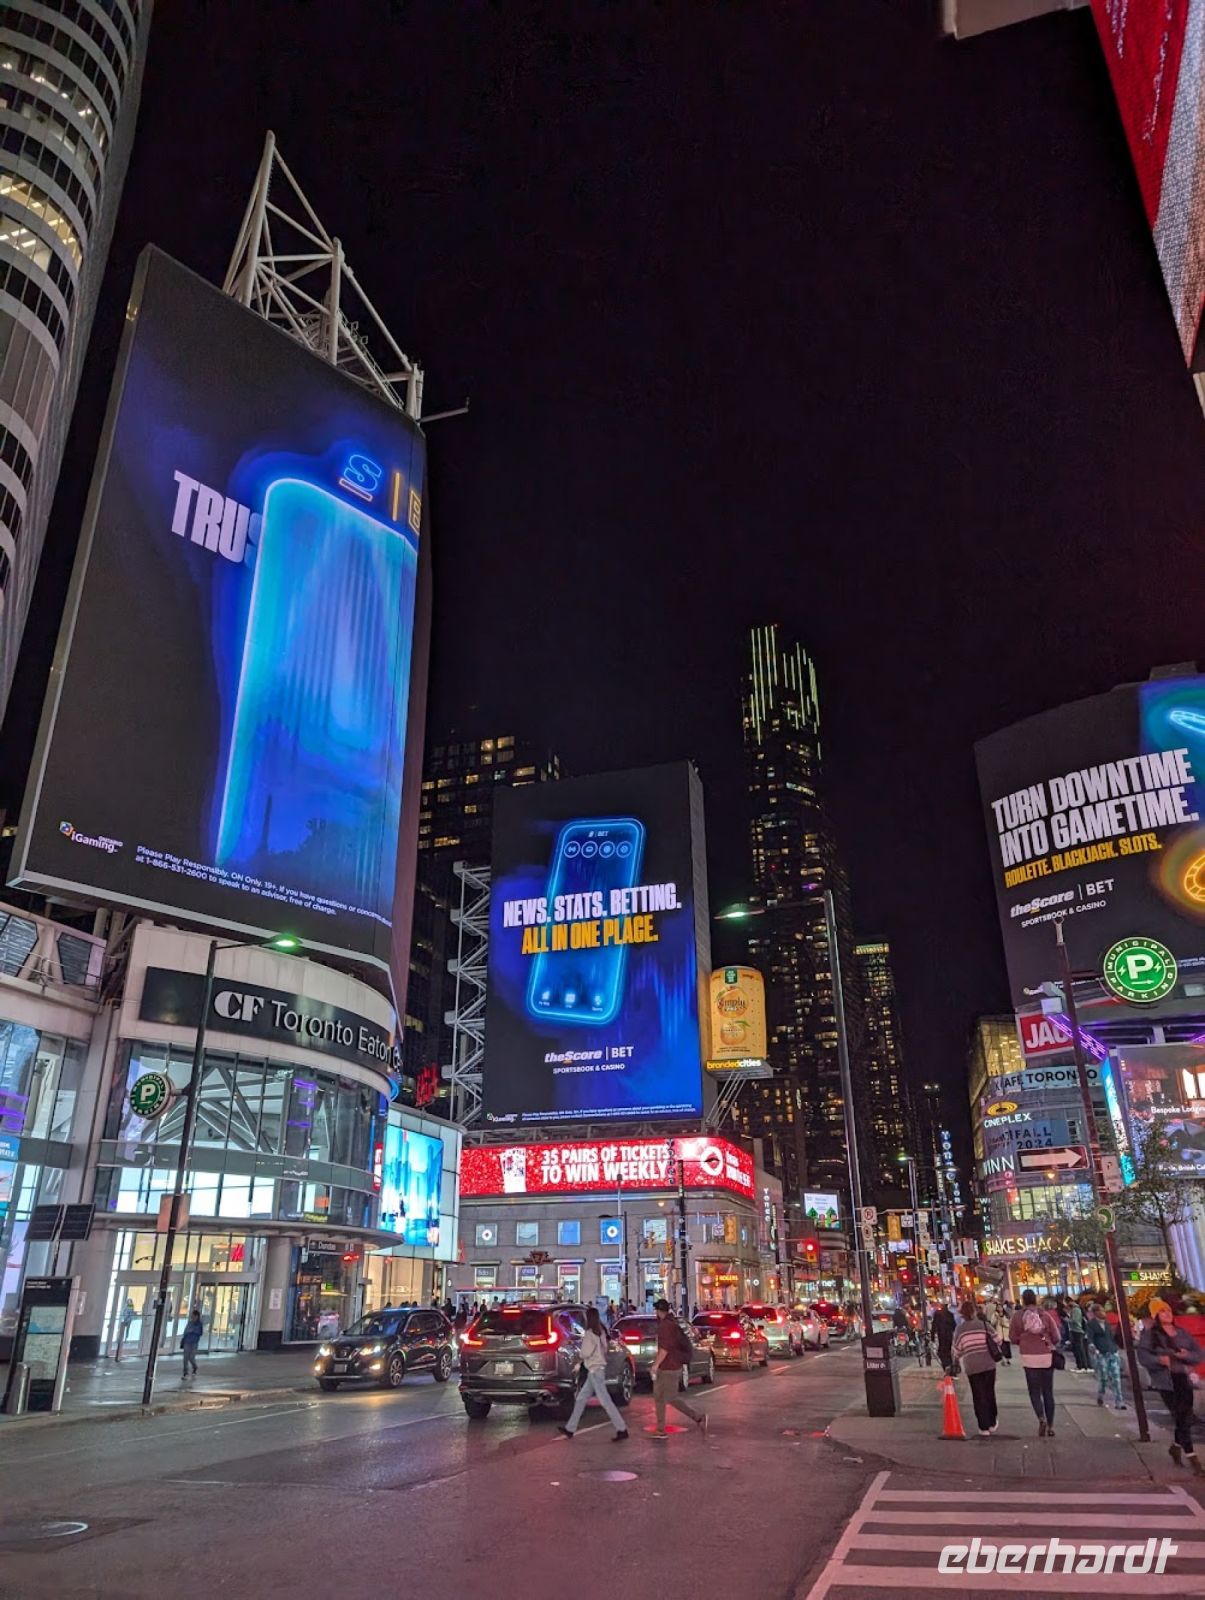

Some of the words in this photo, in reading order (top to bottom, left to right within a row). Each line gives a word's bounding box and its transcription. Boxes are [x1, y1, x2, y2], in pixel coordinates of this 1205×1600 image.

[991, 783, 1050, 834] TURN
[1049, 748, 1195, 813] DOWNTIME
[1000, 819, 1050, 868] INTO
[1051, 786, 1199, 849] GAMETIME.
[71, 831, 118, 854] iGaming
[1004, 858, 1052, 889] ROULETTE.
[1051, 842, 1119, 873] BLACKJACK.
[1119, 832, 1162, 856] SLOTS.
[135, 855, 144, 865] at
[145, 856, 208, 881] 1-866-531-2600
[208, 874, 218, 882] to
[218, 878, 241, 890] speak
[241, 883, 250, 891] to
[250, 887, 261, 895] an
[260, 888, 289, 903] advisor,
[289, 896, 303, 906] free
[303, 900, 312, 908] of
[312, 904, 337, 916] charge.
[136, 845, 164, 859] Please
[164, 853, 182, 865] Play
[182, 858, 229, 878] Responsibly.
[231, 872, 244, 882] ON
[244, 875, 263, 888] Only.
[264, 881, 278, 891] 19+.
[279, 885, 285, 893] If
[286, 888, 299, 898] you
[299, 890, 316, 902] have
[316, 896, 348, 911] questions
[348, 905, 357, 913] or
[503, 897, 552, 928] NEWS.
[553, 890, 608, 922] STATS.
[609, 882, 682, 916] BETTING.
[1010, 890, 1075, 918] theScore
[1085, 878, 1115, 896] BET
[1021, 908, 1068, 929] SPORTSBOOK
[1068, 907, 1075, 915] &
[1075, 899, 1107, 913] CASINO
[521, 923, 550, 955] ALL
[551, 923, 569, 951] IN
[570, 919, 601, 950] ONE
[603, 914, 660, 947] PLACE.
[1106, 940, 1171, 970] MUNICIPAL
[1126, 953, 1154, 980] P
[214, 990, 265, 1022] CF
[271, 1000, 353, 1046] Toronto
[358, 1025, 392, 1064] Eaton
[544, 1050, 603, 1063] theScore
[611, 1046, 634, 1058] BET
[552, 1065, 595, 1074] SPORTSBOOK
[595, 1064, 601, 1072] &
[601, 1063, 625, 1071] CASINO
[1026, 1068, 1098, 1084] TORONO
[141, 1083, 156, 1102] P
[542, 1149, 559, 1165] 35
[561, 1147, 599, 1164] PAIRS
[600, 1145, 618, 1162] OF
[620, 1143, 670, 1161] TICKETS
[541, 1164, 562, 1184] TO
[565, 1162, 600, 1183] WIN
[602, 1160, 669, 1181] WEEKLY
[985, 1238, 1016, 1256] SHAKE
